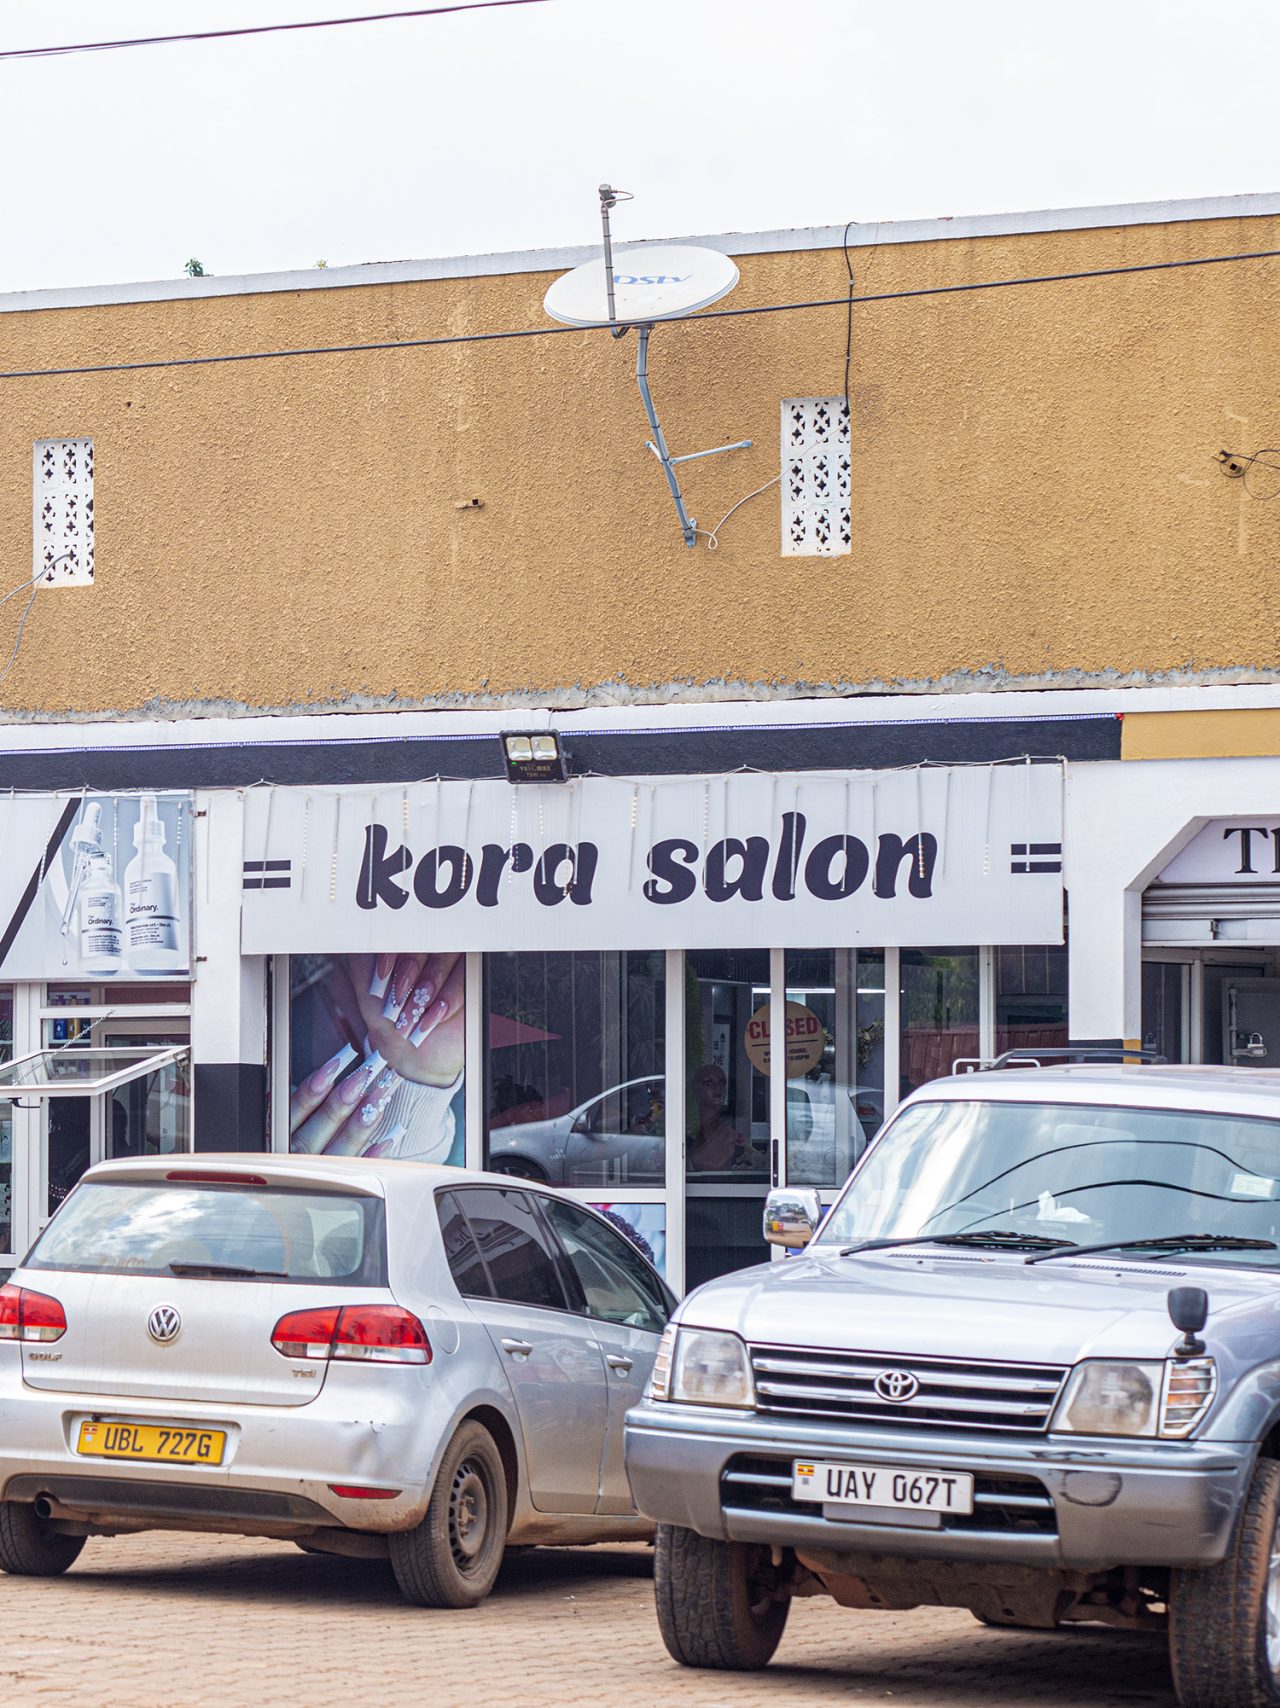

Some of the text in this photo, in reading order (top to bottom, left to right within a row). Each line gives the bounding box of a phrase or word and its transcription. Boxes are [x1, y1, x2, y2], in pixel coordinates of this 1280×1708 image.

[356, 811, 938, 911] kora salon
[1223, 827, 1280, 874] T
[749, 1017, 818, 1039] CLSED
[28, 1352, 63, 1361] GOLF
[104, 1426, 211, 1457] UBL 727G
[826, 1468, 957, 1507] UAY 067T
